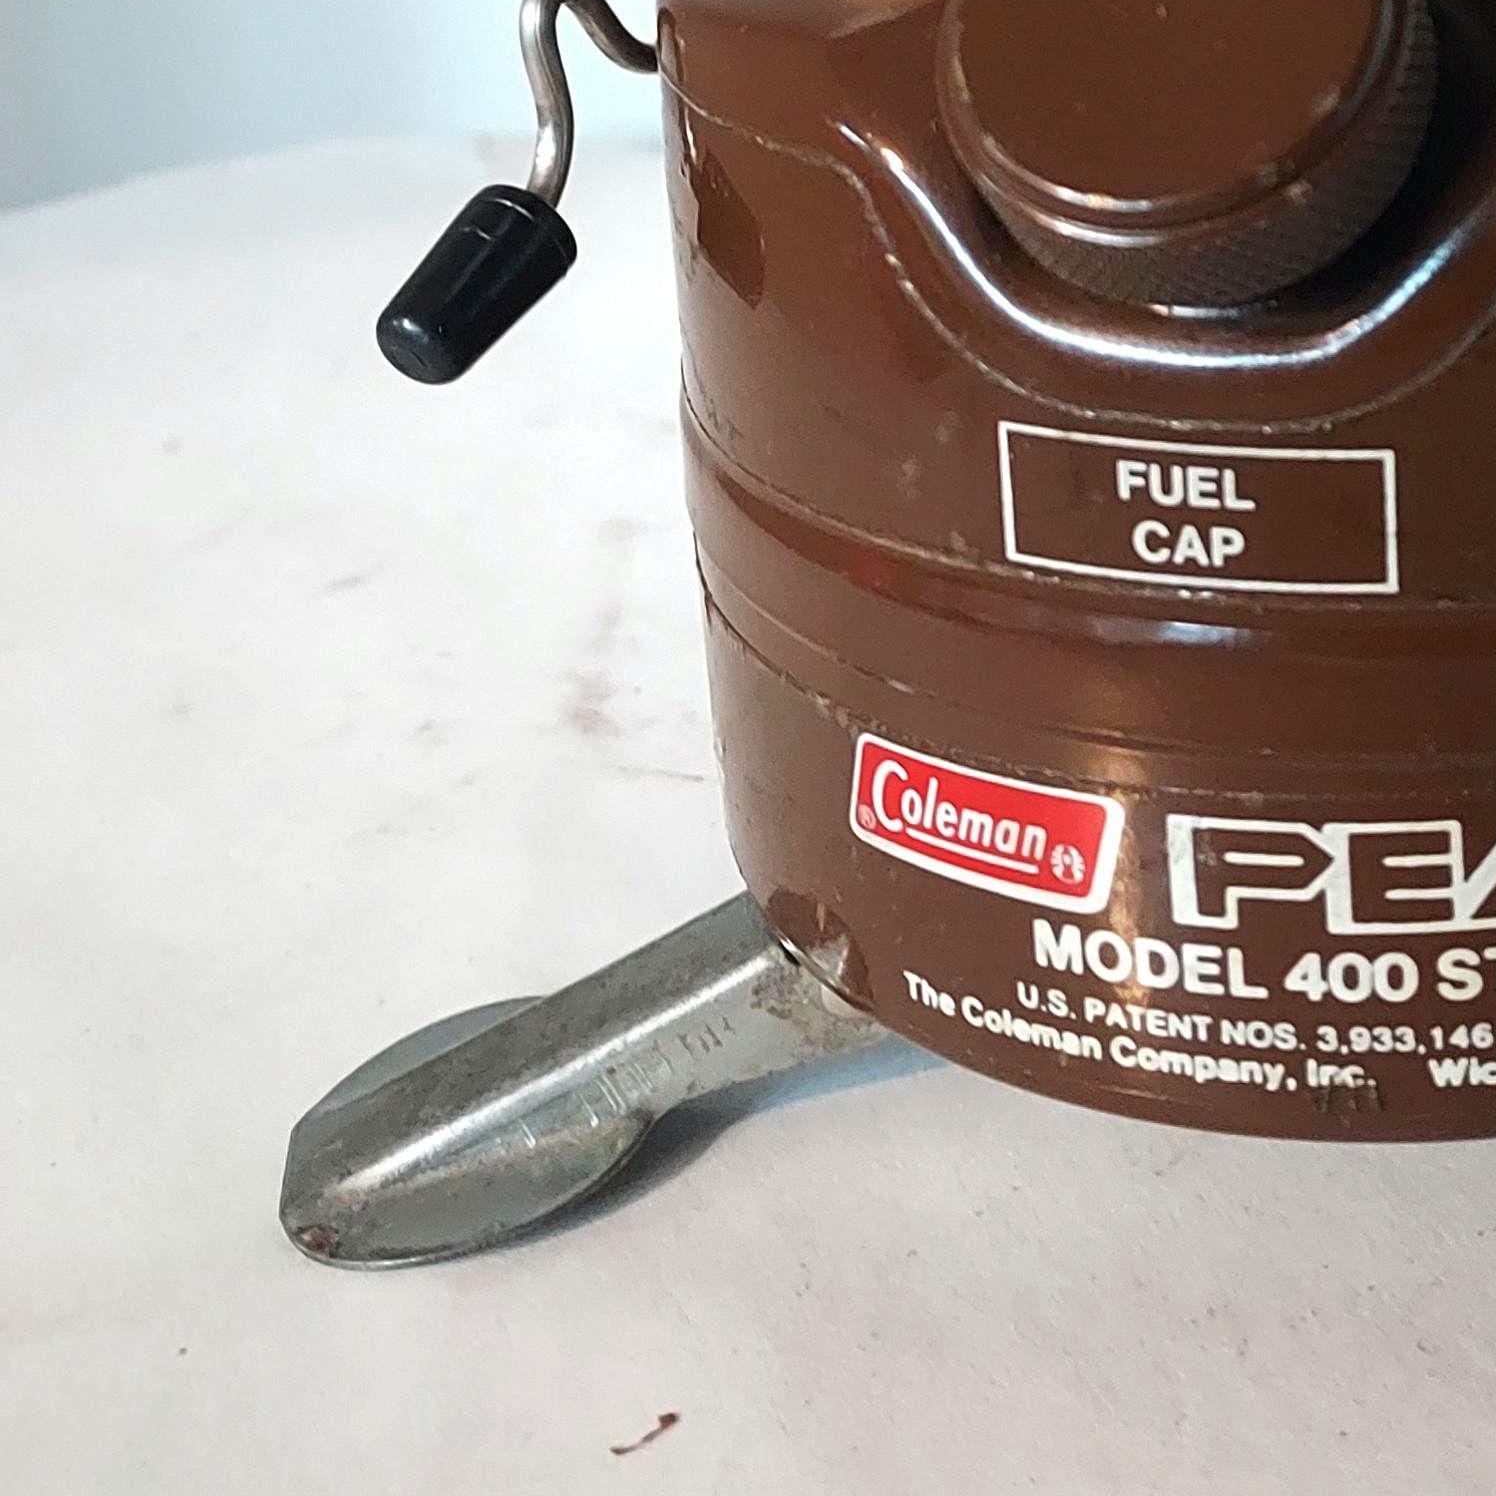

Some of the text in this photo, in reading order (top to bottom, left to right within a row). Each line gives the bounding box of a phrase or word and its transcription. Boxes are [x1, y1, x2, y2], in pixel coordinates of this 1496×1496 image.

[1116, 459, 1257, 512] FUEL
[1131, 520, 1246, 568] CAP
[871, 759, 1047, 861] Coleman
[1032, 919, 1269, 1000] MODEL
[1284, 952, 1420, 1003] 400
[903, 970, 957, 1018] The
[961, 995, 1104, 1061] Coleman
[1110, 1035, 1298, 1092] Company,
[1016, 981, 1076, 1021] U.S.
[1085, 997, 1213, 1044] PATENT
[1220, 1017, 1307, 1052] NOS.
